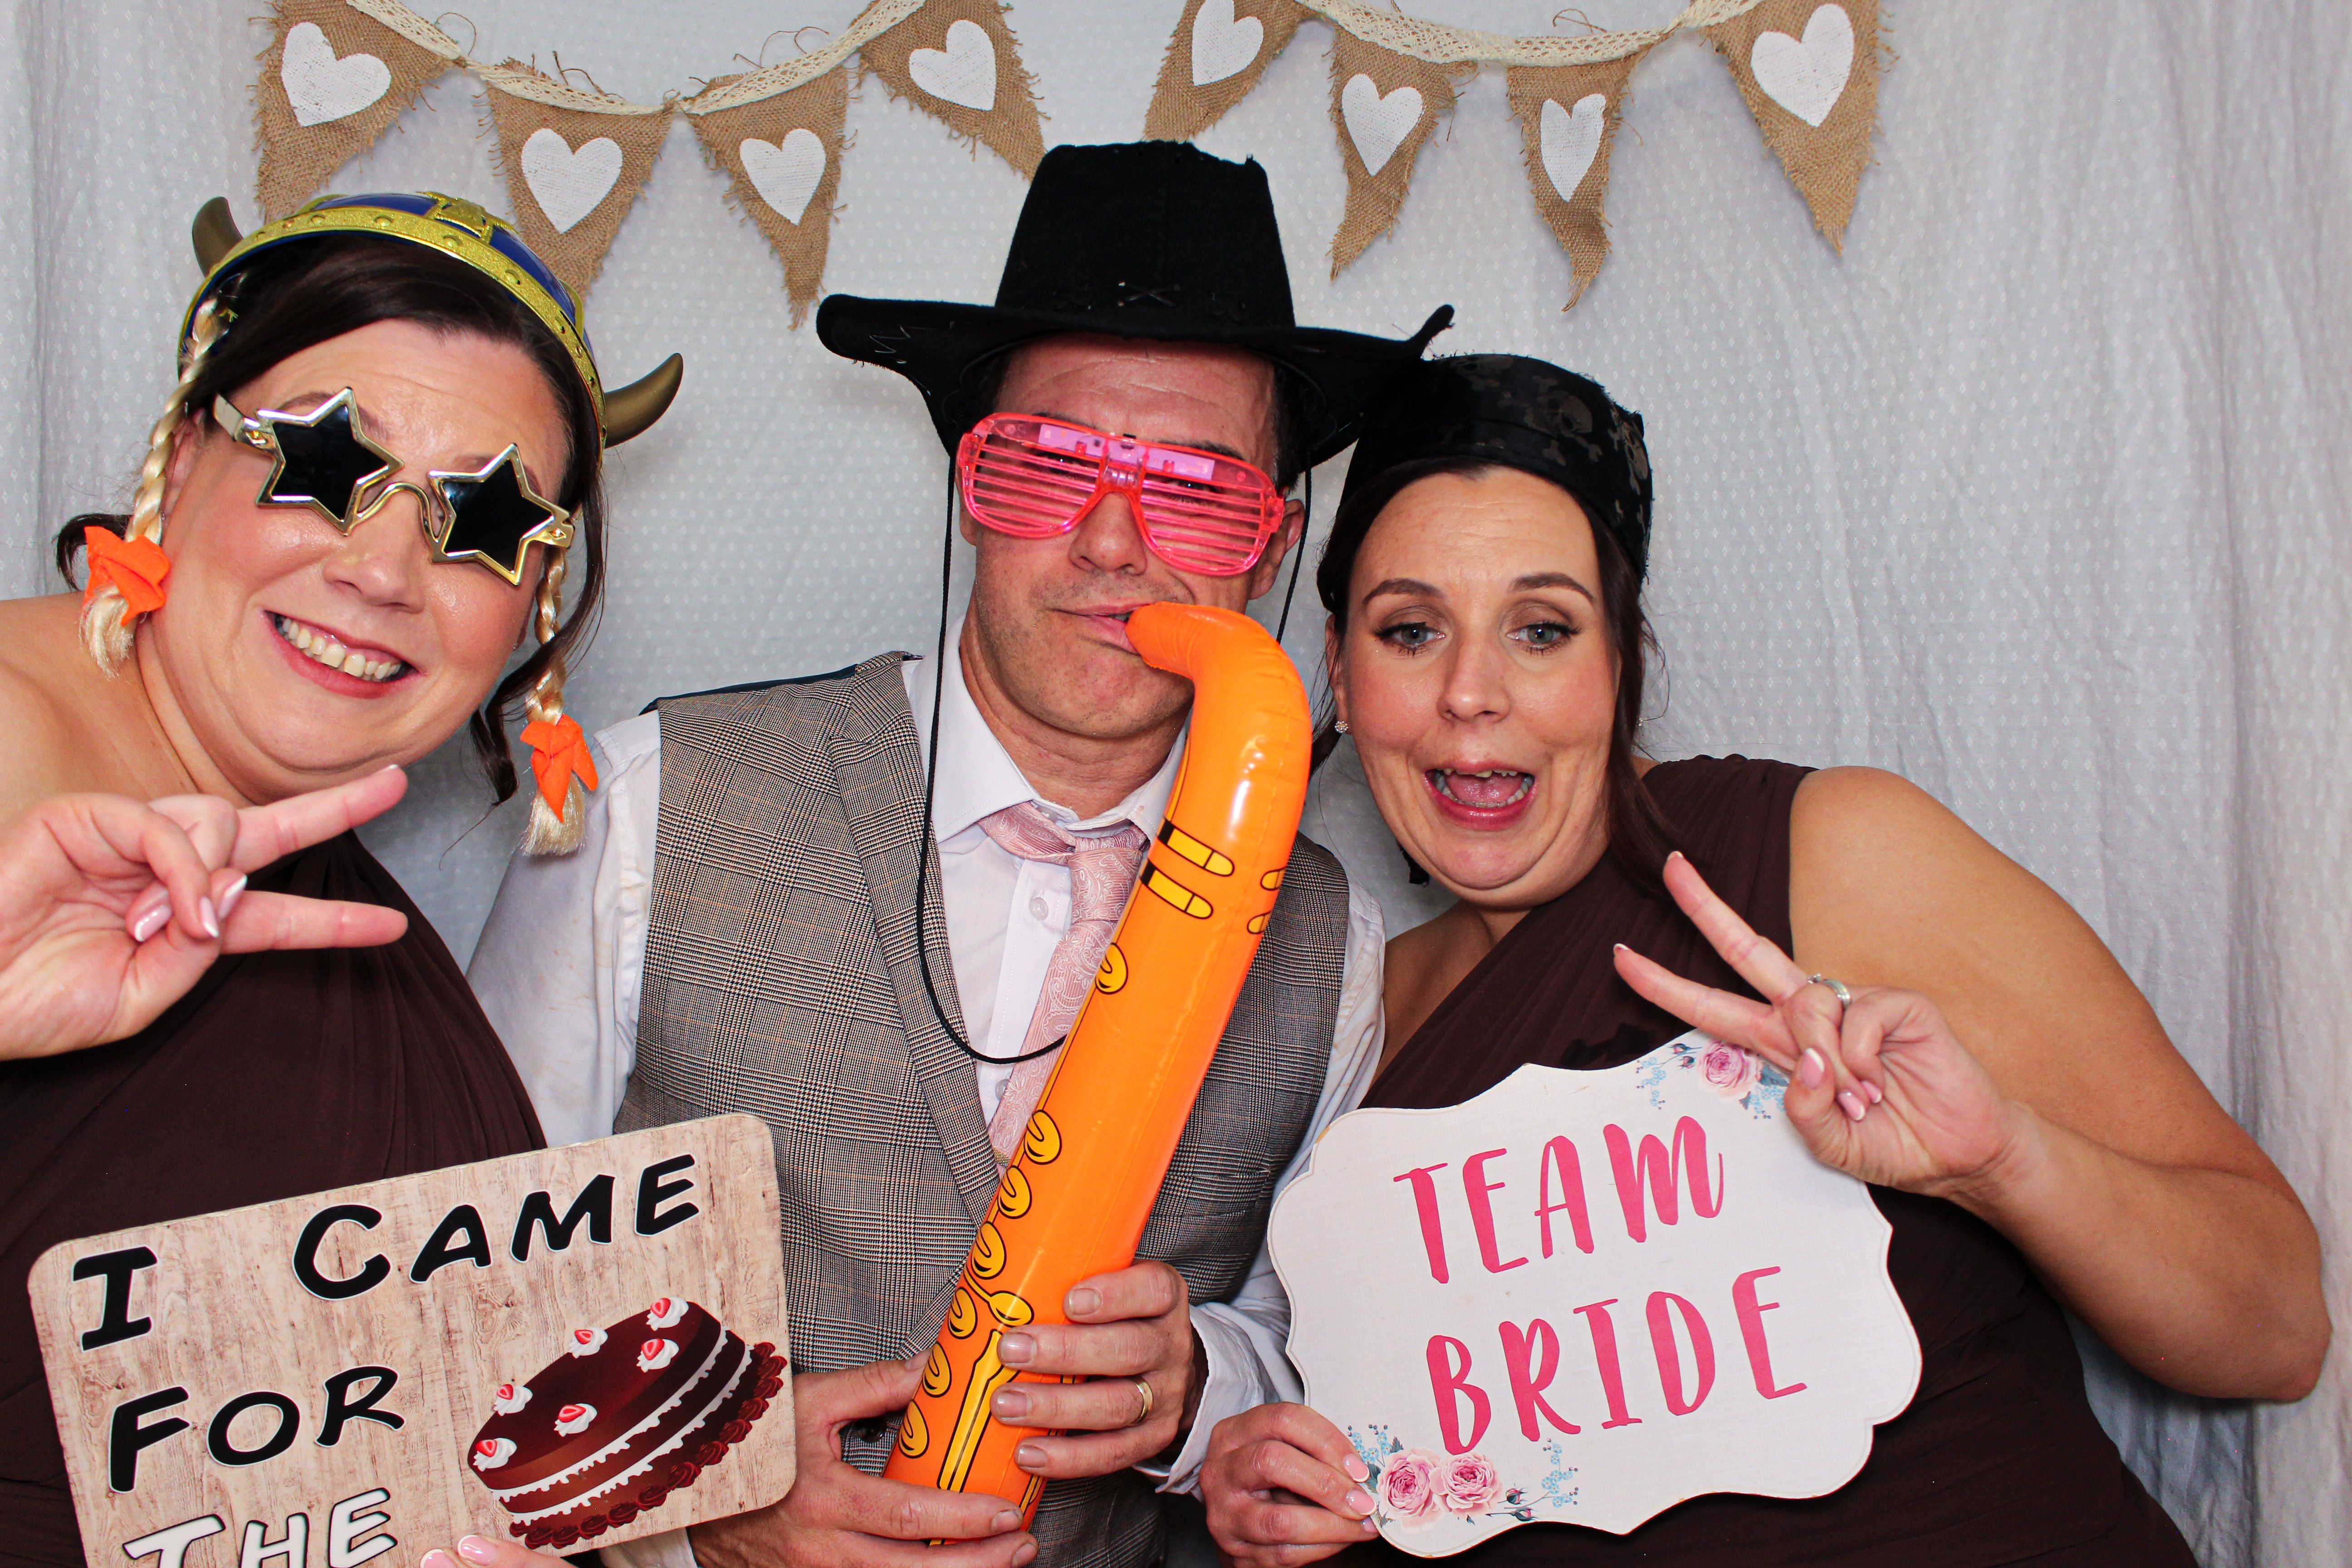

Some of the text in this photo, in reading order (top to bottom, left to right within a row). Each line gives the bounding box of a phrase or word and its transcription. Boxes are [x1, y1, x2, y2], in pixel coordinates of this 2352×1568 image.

[72, 1154, 700, 1351] I CAME
[1394, 1116, 1723, 1283] TEAM
[109, 1366, 405, 1493] FOR
[1427, 1266, 1807, 1455] BRIDE
[122, 1487, 398, 1568] THE
